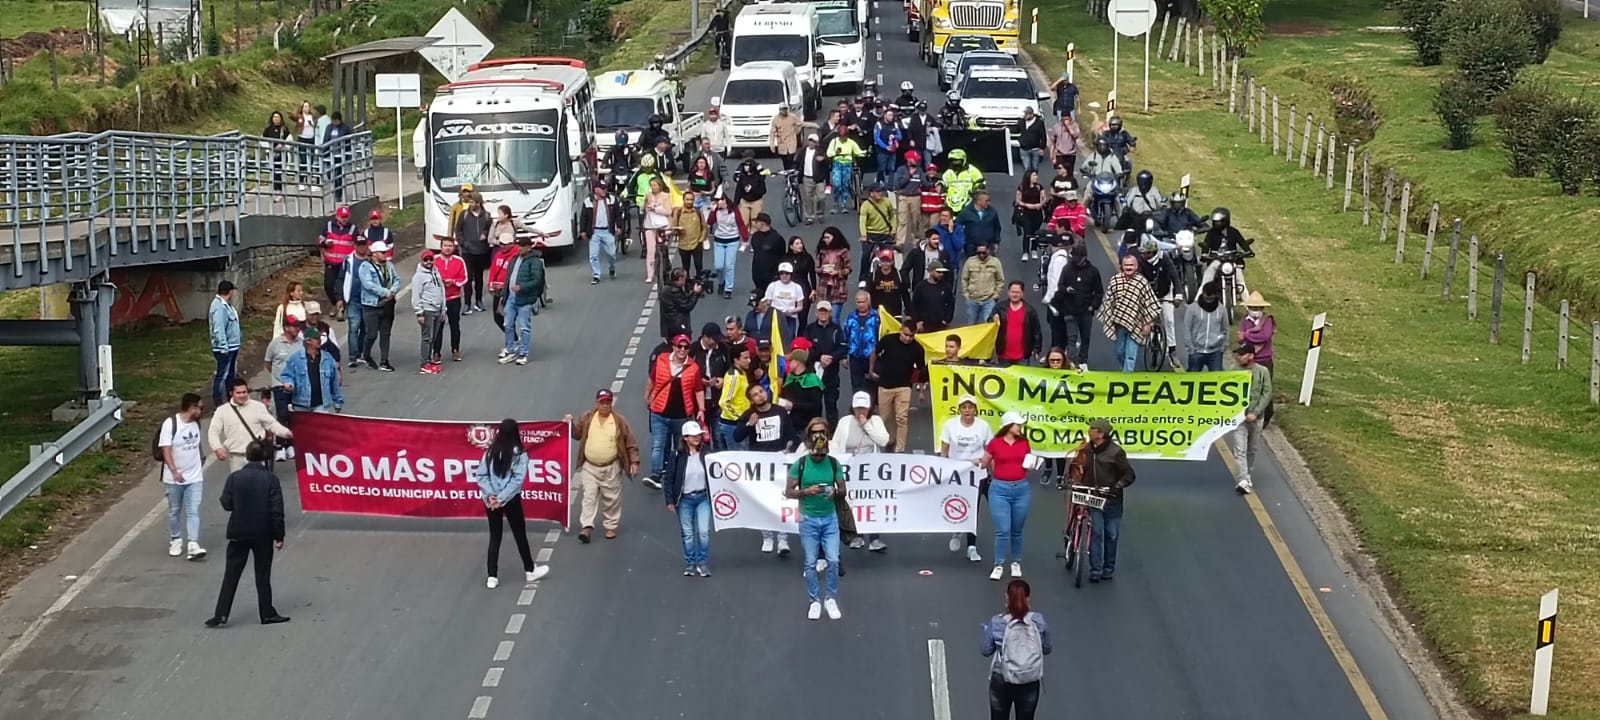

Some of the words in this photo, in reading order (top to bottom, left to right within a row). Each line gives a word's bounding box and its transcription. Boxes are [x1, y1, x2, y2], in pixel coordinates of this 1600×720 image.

[941, 373, 1006, 401] ¡NO
[1018, 374, 1096, 405] MÁS
[1106, 381, 1250, 407] PEAJES!
[1152, 416, 1184, 424] entre
[1187, 416, 1194, 424] 5
[1198, 416, 1238, 427] peajes
[304, 452, 354, 478] NO
[361, 449, 436, 482] MÁS
[443, 459, 562, 485] PEES
[309, 483, 322, 492] EL
[323, 484, 380, 496] CONCEJO
[382, 488, 447, 499] MUNICIPAL
[449, 490, 465, 499] DE
